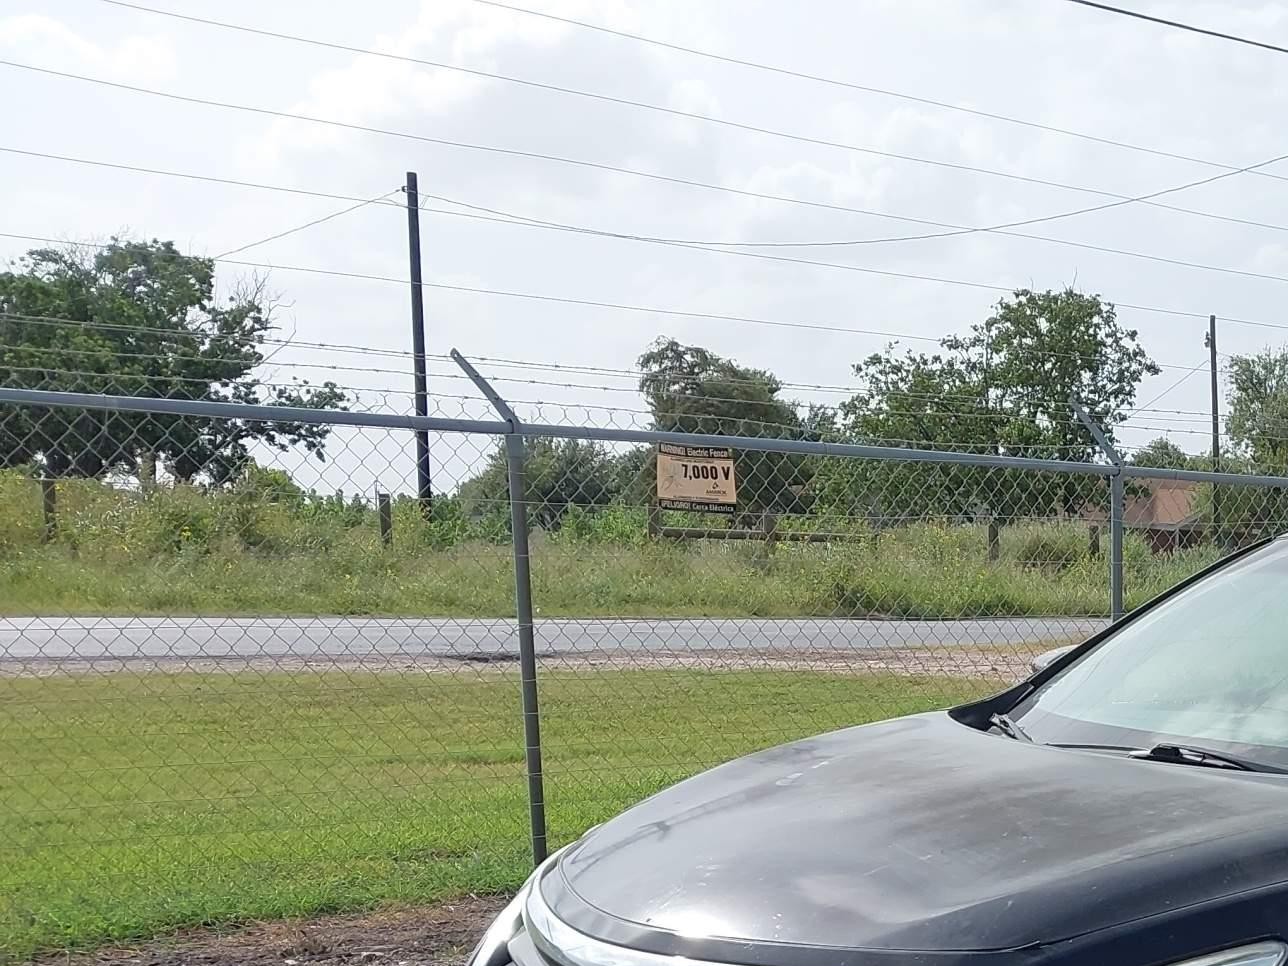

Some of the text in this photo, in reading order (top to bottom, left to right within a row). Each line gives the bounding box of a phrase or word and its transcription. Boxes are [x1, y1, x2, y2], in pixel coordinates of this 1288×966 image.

[687, 447, 708, 457] Electric
[709, 448, 728, 458] Fence
[681, 464, 731, 481] 7,000 V
